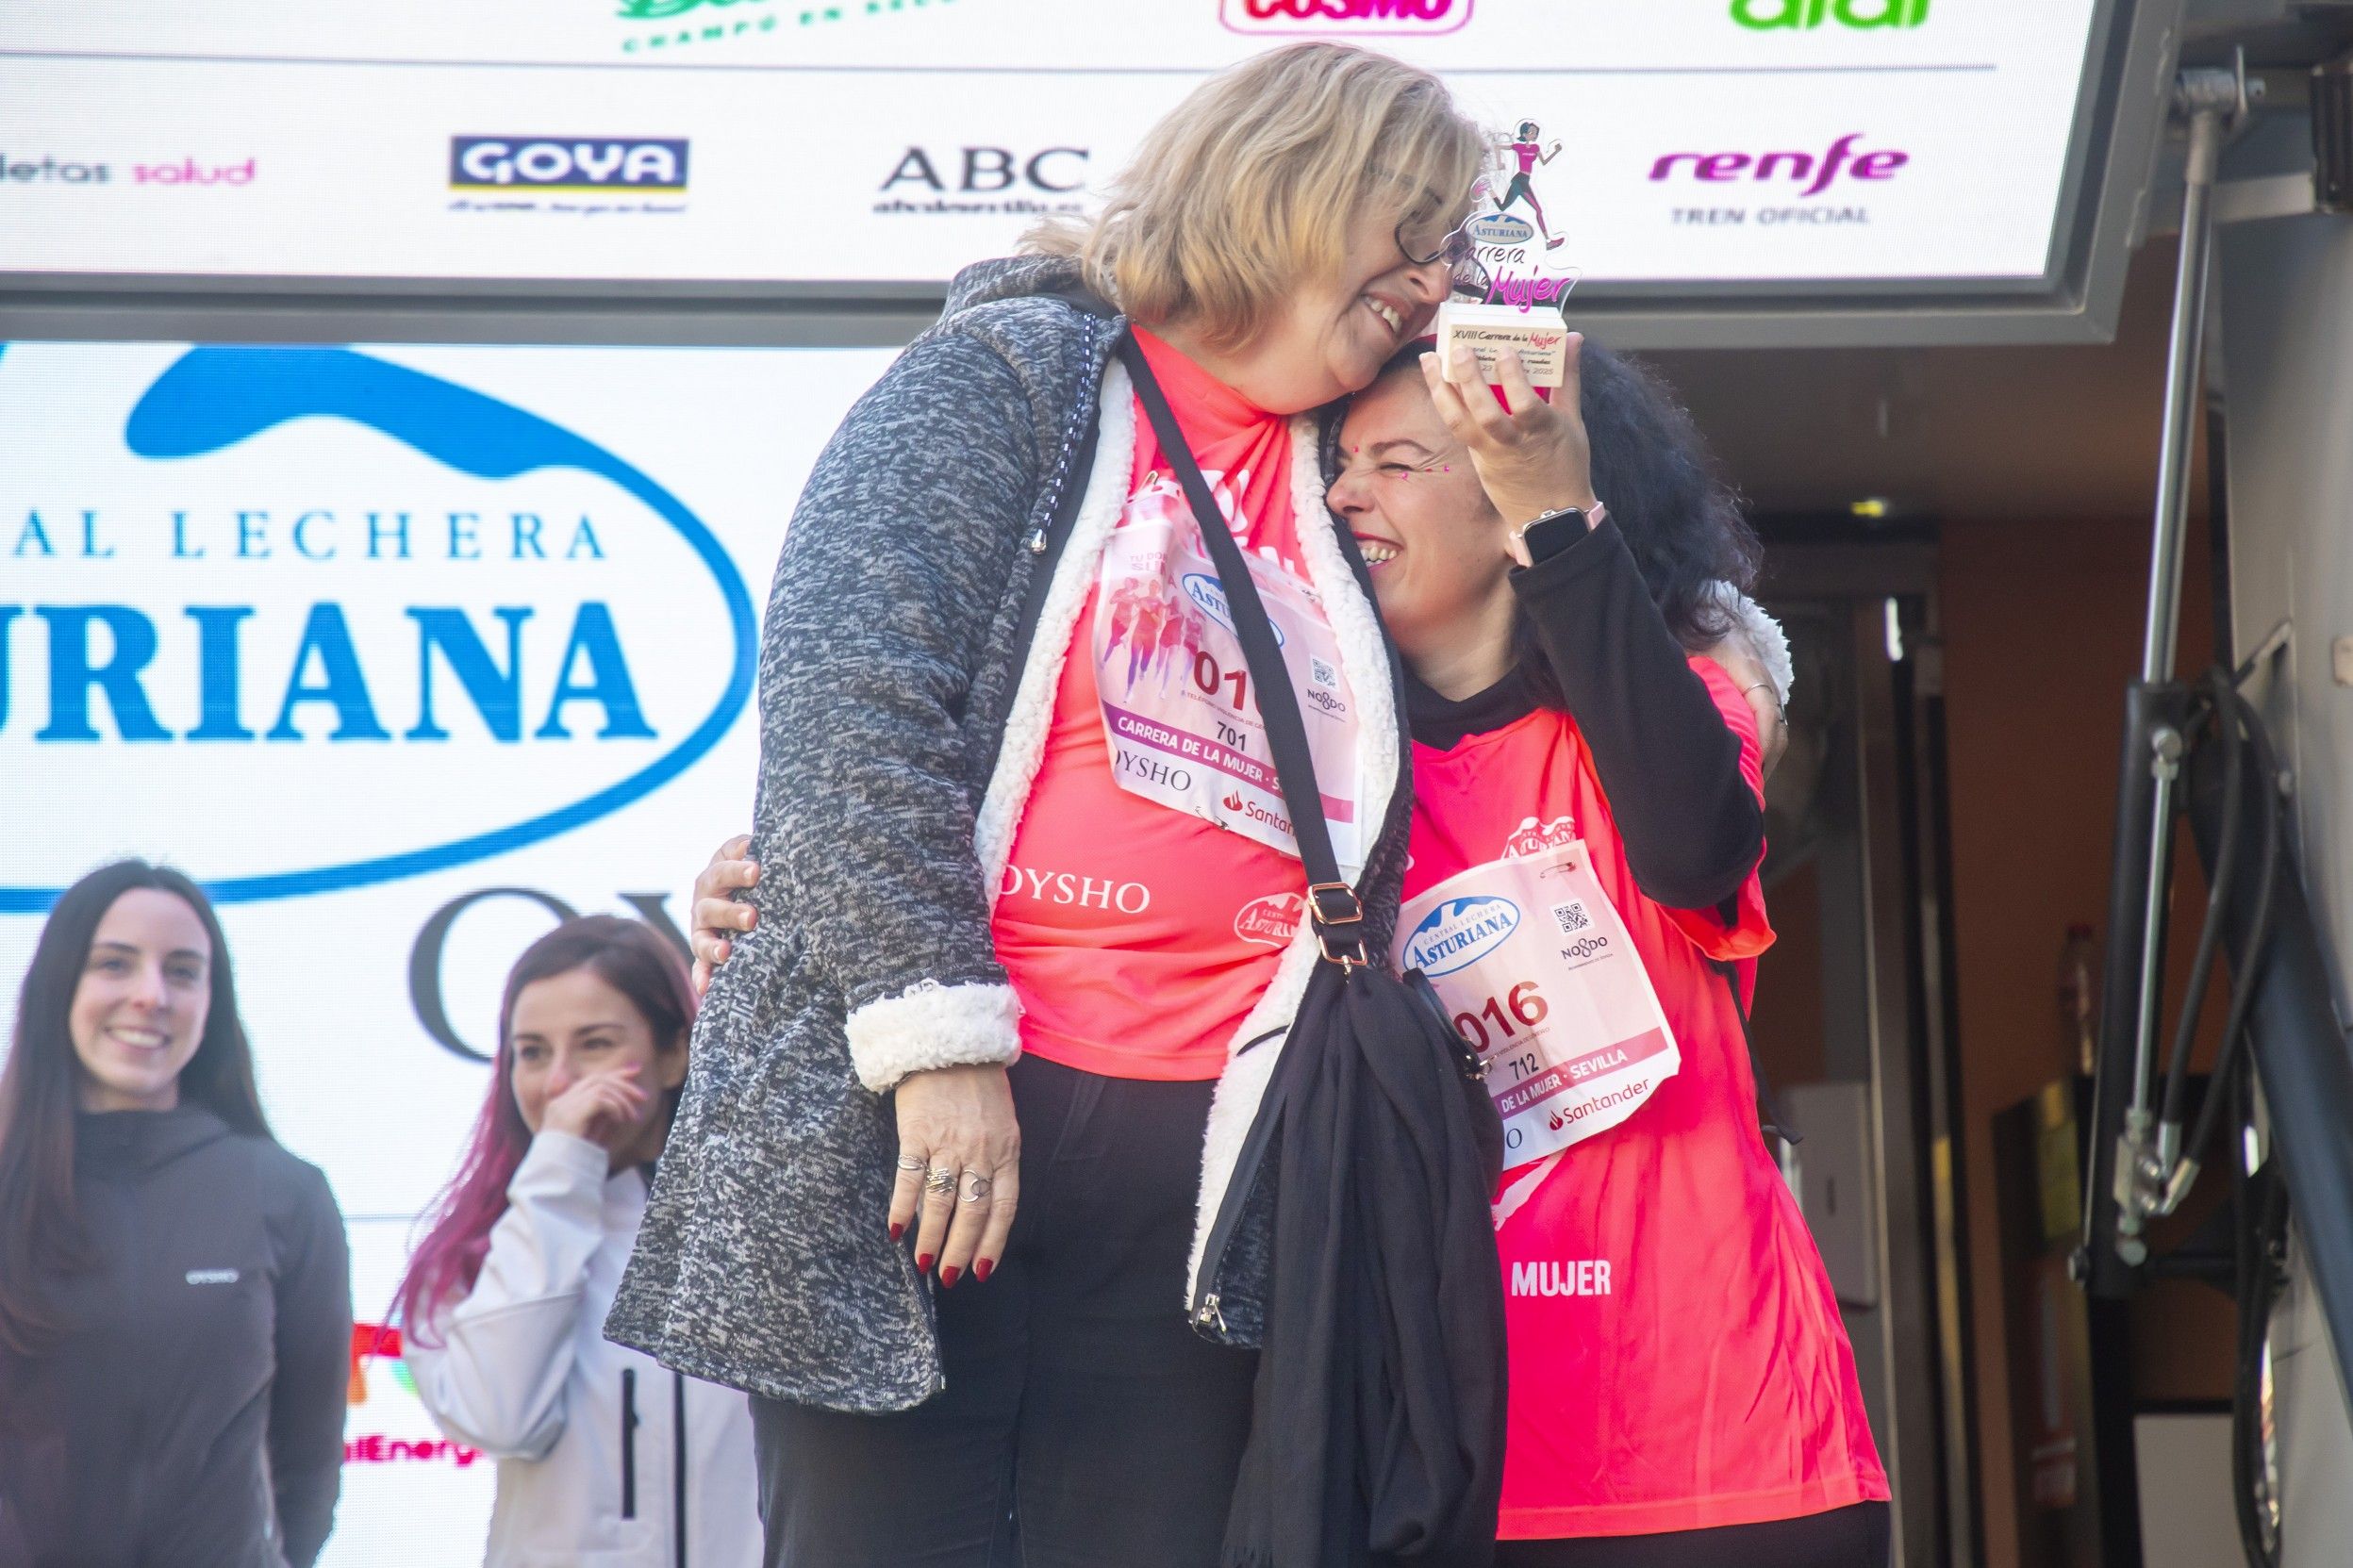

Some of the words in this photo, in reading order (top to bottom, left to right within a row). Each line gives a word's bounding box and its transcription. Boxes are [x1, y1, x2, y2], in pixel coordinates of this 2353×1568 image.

[133, 157, 256, 187] salud
[461, 141, 676, 184] GOYA
[879, 146, 1090, 192] ABC
[1649, 131, 1910, 197] renfe
[1670, 206, 1745, 224] TREN
[1756, 206, 1871, 225] OFICIAL
[1484, 265, 1570, 314] Mujer
[1528, 332, 1562, 350] Mujer
[171, 509, 606, 559] LECHERA
[1118, 716, 1178, 750] CARRERA
[1182, 738, 1201, 756] DE
[1203, 745, 1221, 764] LA
[1223, 753, 1263, 783] MUJER
[1217, 720, 1247, 751] 701
[1116, 750, 1191, 791] YSHO
[1245, 801, 1297, 837] Santan
[1453, 981, 1549, 1054] 016
[1500, 1098, 1516, 1113] DE
[1516, 1090, 1531, 1105] LA
[1529, 1073, 1563, 1098] MUJER
[1569, 1048, 1628, 1080] SEVILLA
[1509, 1052, 1539, 1081] 712
[1563, 1079, 1649, 1124] Santander
[1511, 1259, 1612, 1296] MUJER
